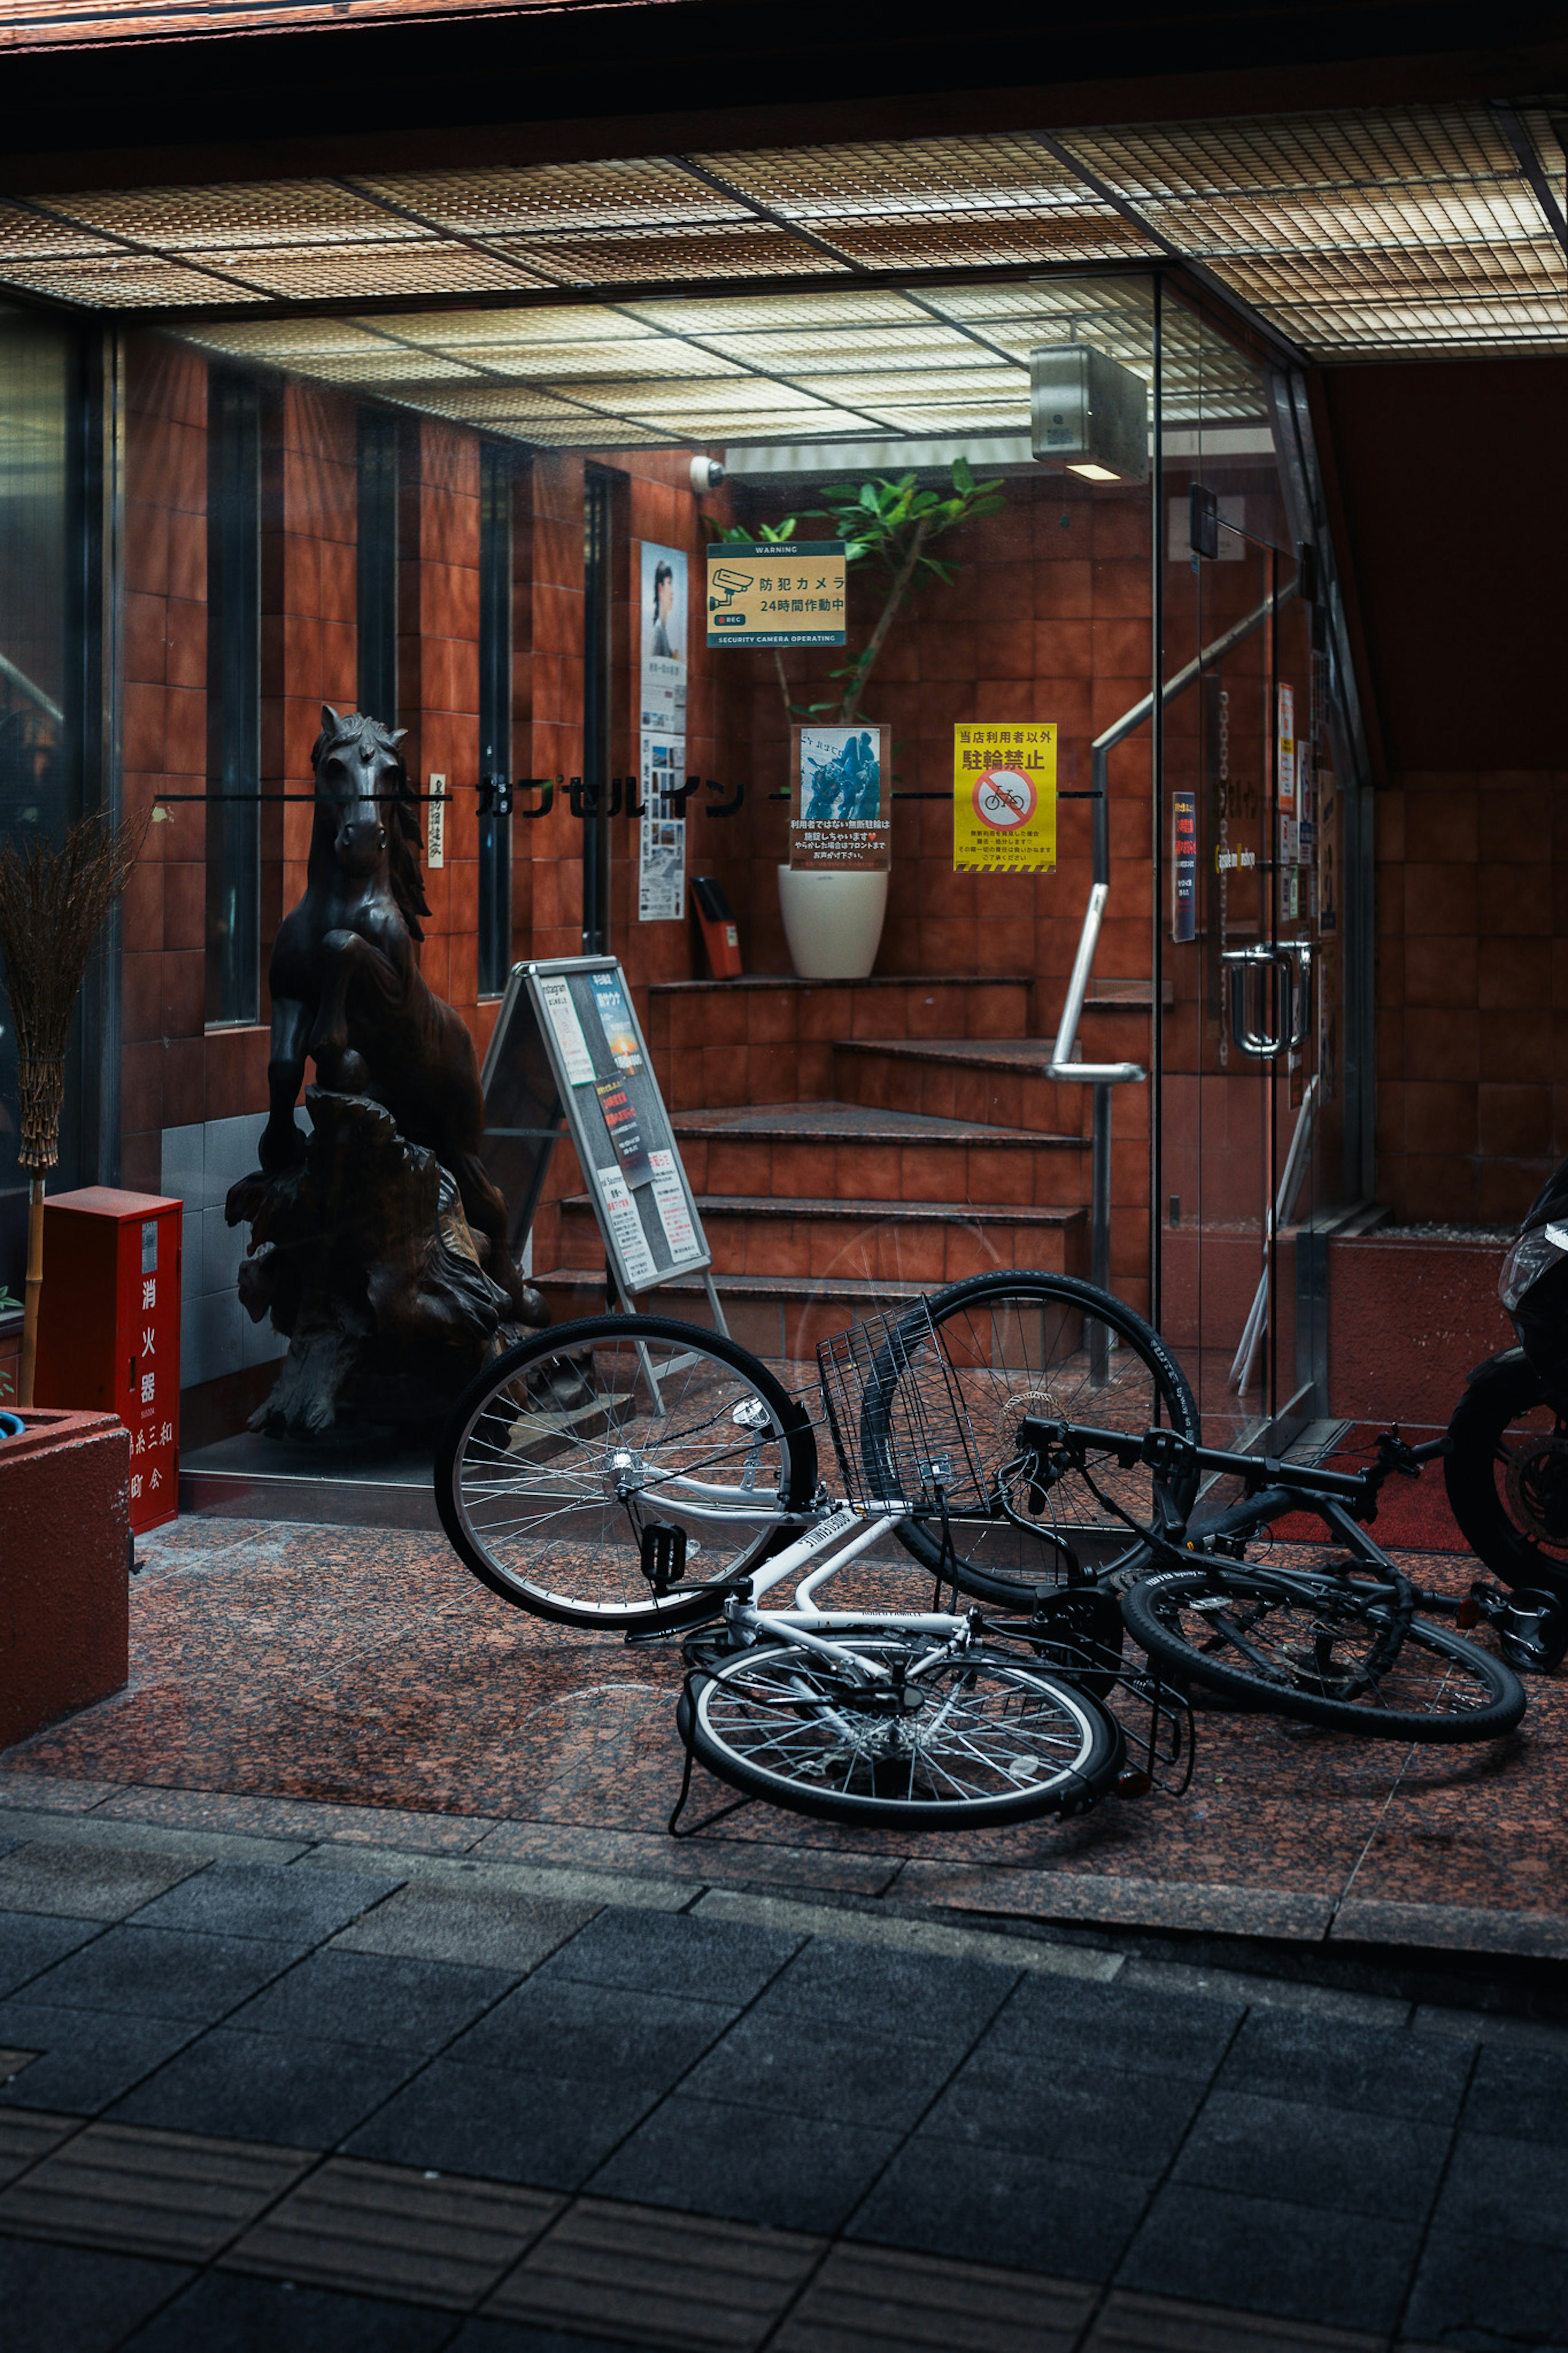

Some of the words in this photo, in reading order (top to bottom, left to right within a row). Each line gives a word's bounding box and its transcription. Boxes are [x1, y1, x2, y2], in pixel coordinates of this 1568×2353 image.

[760, 576, 844, 591] 防犯カメラ
[760, 598, 844, 612] 24時間作動中
[960, 731, 1051, 744] 当店利用者以外
[962, 750, 1045, 770] 駐輪禁止
[476, 775, 744, 818] カプセルイン
[795, 841, 886, 850] やらかした場合はフロントまで
[141, 1278, 156, 1403] 消火器
[140, 1407, 155, 1419] SUS304
